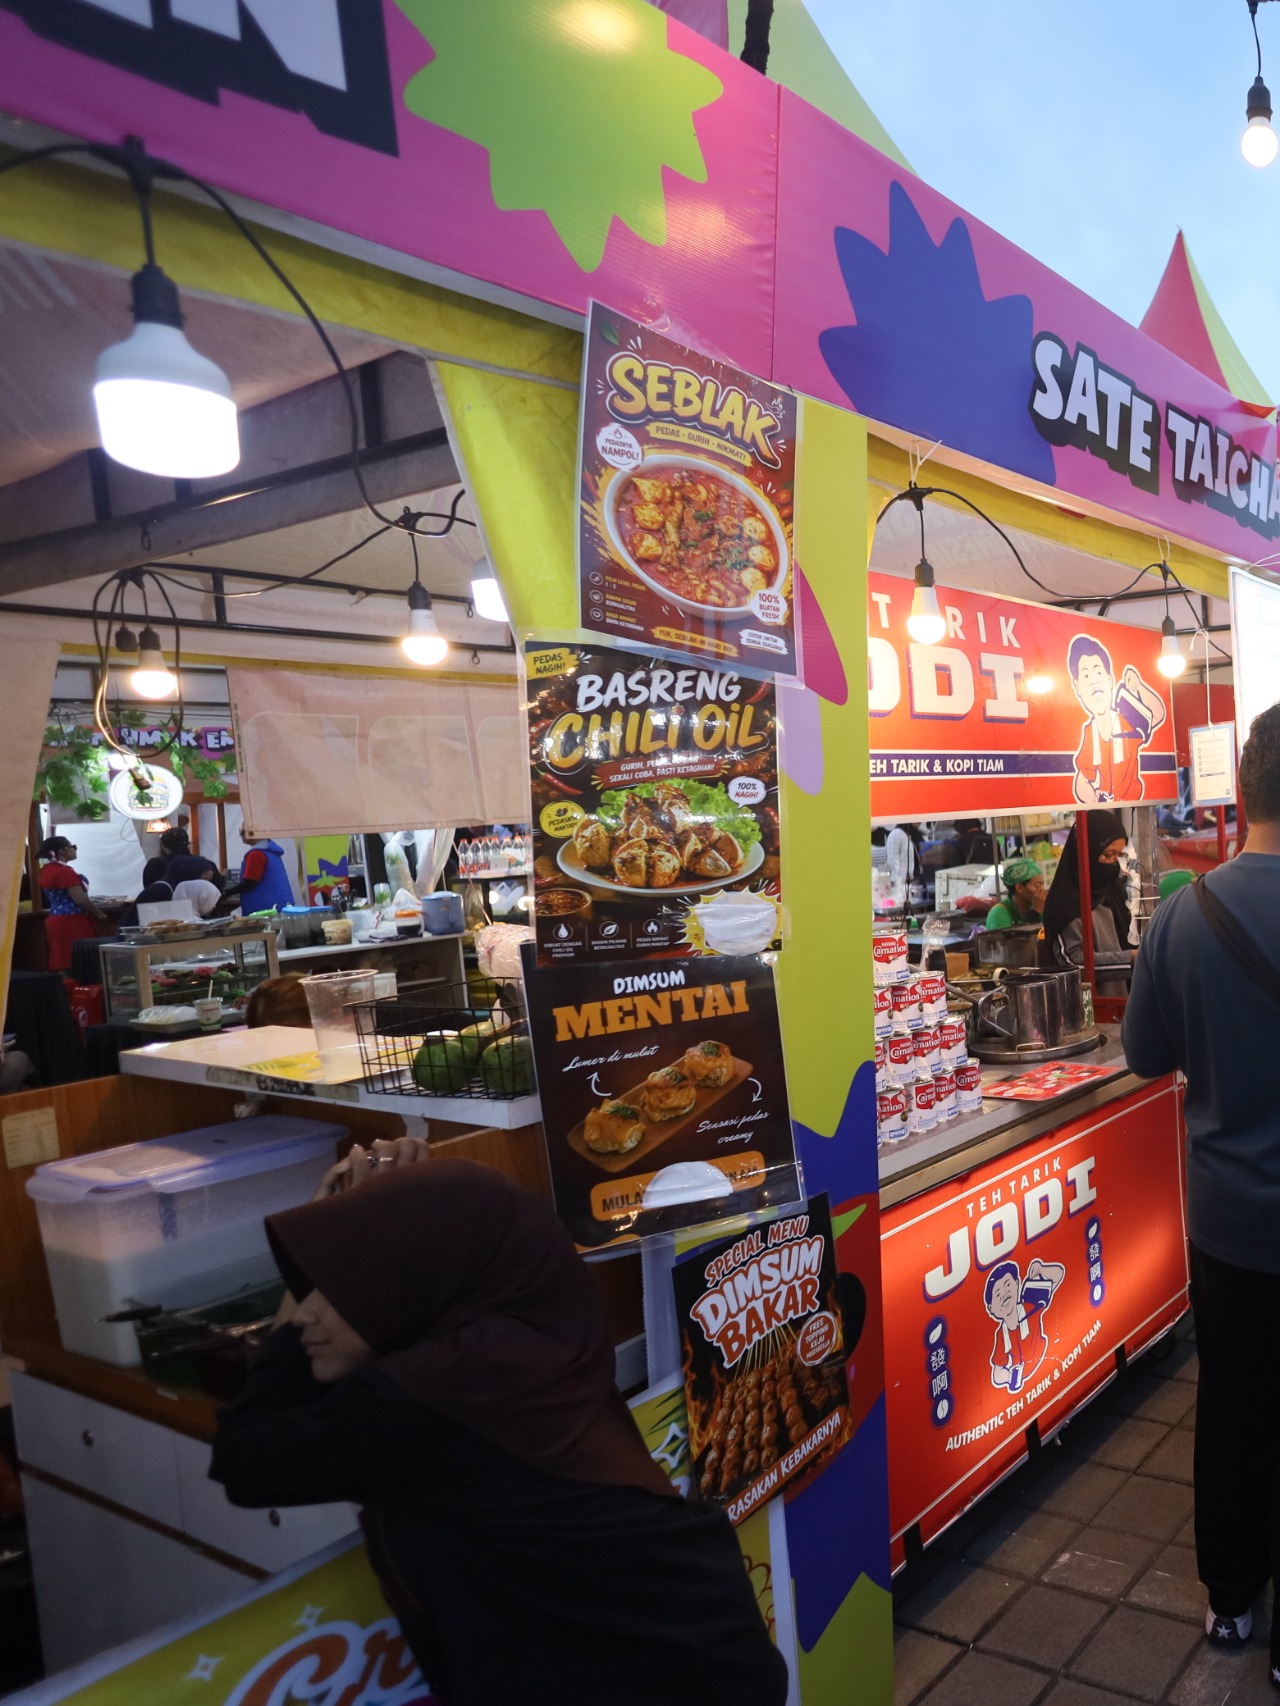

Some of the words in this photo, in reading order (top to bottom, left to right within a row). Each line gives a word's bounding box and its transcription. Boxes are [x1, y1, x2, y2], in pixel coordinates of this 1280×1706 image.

[609, 355, 779, 463] SEBLAK
[1032, 339, 1154, 473] SATE
[601, 445, 640, 462] NAMPOL!
[655, 425, 681, 438] PEDAS
[687, 432, 710, 446] GURIH
[716, 441, 747, 461] NIKMAT!
[758, 592, 780, 605] 100%
[759, 604, 781, 613] BUATAN
[761, 611, 780, 620] FRESH
[871, 592, 1021, 649] TRIK
[533, 654, 563, 666] PEDAS
[535, 661, 567, 675] NAGIH!
[576, 669, 742, 713] BASRENG
[609, 772, 633, 783] SEKALI
[656, 767, 676, 777] PASTI
[676, 763, 715, 775] KETAGIHAN!
[891, 758, 930, 774] TARIK
[933, 759, 942, 773] &
[946, 758, 974, 773] KOPI
[976, 758, 1005, 772] TIAM
[734, 790, 760, 800] NAGIH!
[737, 781, 758, 791] 100%
[613, 969, 686, 995] DIMSUM
[552, 980, 750, 1042] MENTAI
[561, 1053, 605, 1072] Lumer
[605, 1050, 621, 1064] di
[622, 1044, 661, 1062] mulut
[696, 1117, 738, 1134] Sensasi
[738, 1110, 770, 1129] pedas
[717, 1129, 755, 1144] creamy
[966, 1184, 1002, 1218] TEH
[1009, 1156, 1063, 1196] TARIK
[924, 1155, 1098, 1300] JODI
[704, 1229, 765, 1287] SPECIAL
[768, 1214, 810, 1245] MENU
[693, 1238, 824, 1336] DIMSUM
[716, 1278, 819, 1367] BAKAR
[809, 1317, 825, 1333] FREE
[811, 1334, 825, 1349] KEJU
[945, 1412, 1005, 1452] AUTHENTIC
[1005, 1398, 1024, 1420] TEH
[1026, 1375, 1053, 1405] TARIK
[1053, 1368, 1061, 1381] &
[1061, 1344, 1082, 1372] KOPI
[1081, 1319, 1102, 1348] TIAM
[780, 1412, 841, 1475] KEBAKARNYA
[726, 1471, 779, 1521] RASAKAN
